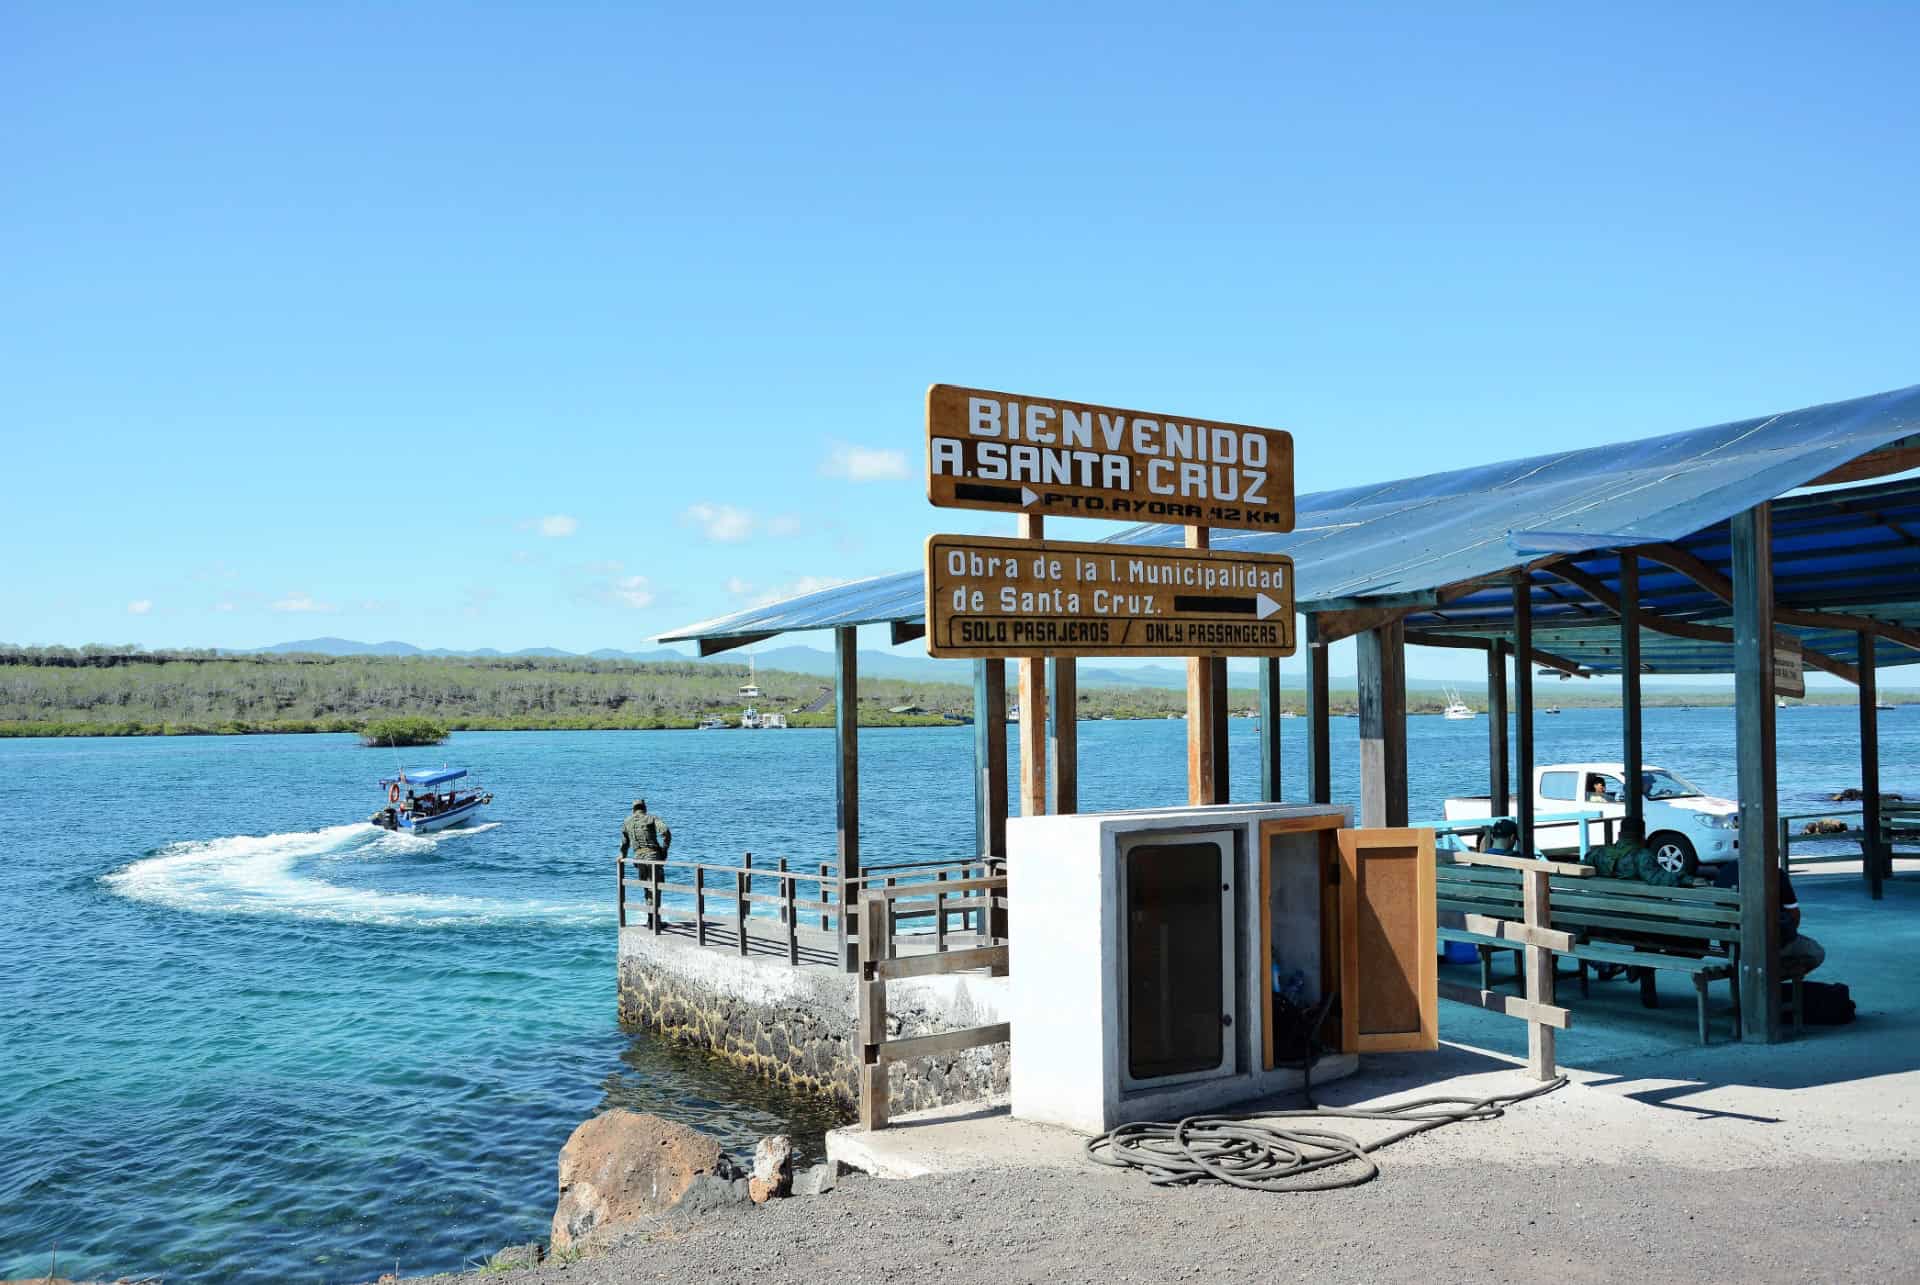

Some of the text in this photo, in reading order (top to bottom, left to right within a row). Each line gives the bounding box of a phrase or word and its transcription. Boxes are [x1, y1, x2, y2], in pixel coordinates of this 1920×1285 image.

[968, 397, 1267, 467] BIENVENIDO
[1210, 509, 1241, 521] 42
[1247, 510, 1281, 523] KM
[947, 550, 1019, 579] Obra
[1033, 555, 1063, 580] de
[1076, 557, 1098, 582] la
[1129, 561, 1284, 590] Municipalidad
[952, 585, 1163, 615] de Santa Cruz.
[962, 621, 1007, 642] SOLO
[1013, 621, 1109, 642] PASAJEROS
[1146, 623, 1183, 643] ONLY
[1188, 624, 1277, 644] PASSANGERS
